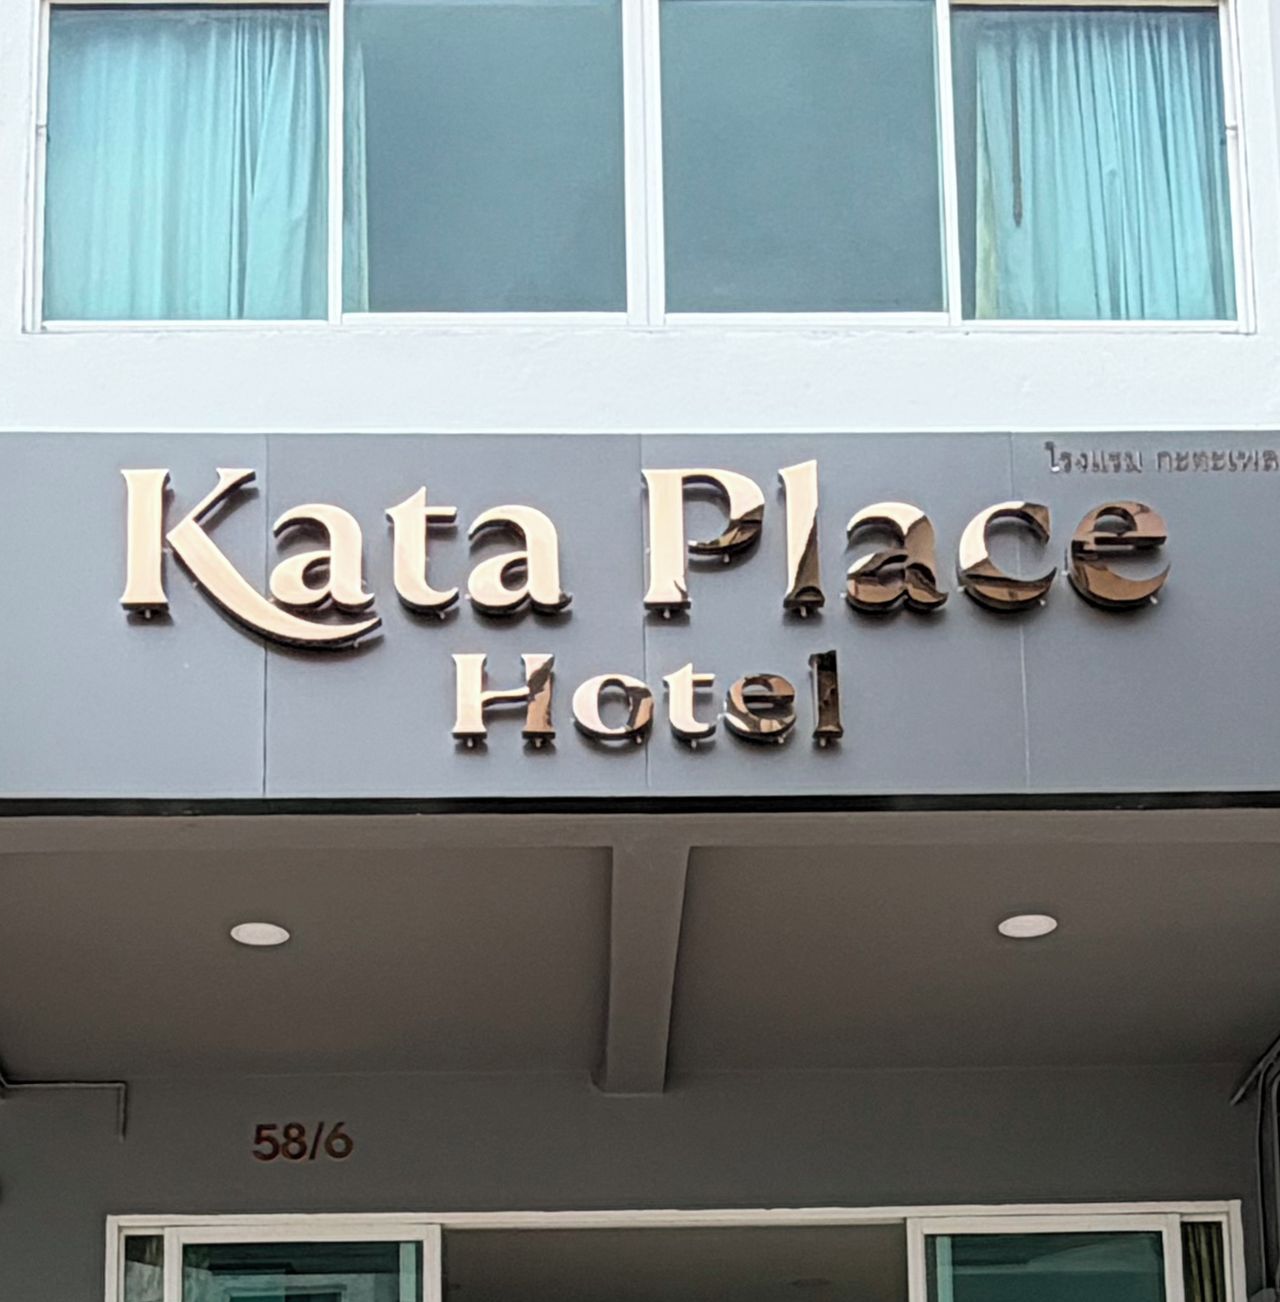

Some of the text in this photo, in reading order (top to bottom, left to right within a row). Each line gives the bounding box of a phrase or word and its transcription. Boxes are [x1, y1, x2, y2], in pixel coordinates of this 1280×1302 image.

[1044, 440, 1143, 474] โรงแรม
[120, 459, 1171, 652] Kata Place
[451, 649, 844, 740] Hotel
[252, 1121, 354, 1161] 58/6
